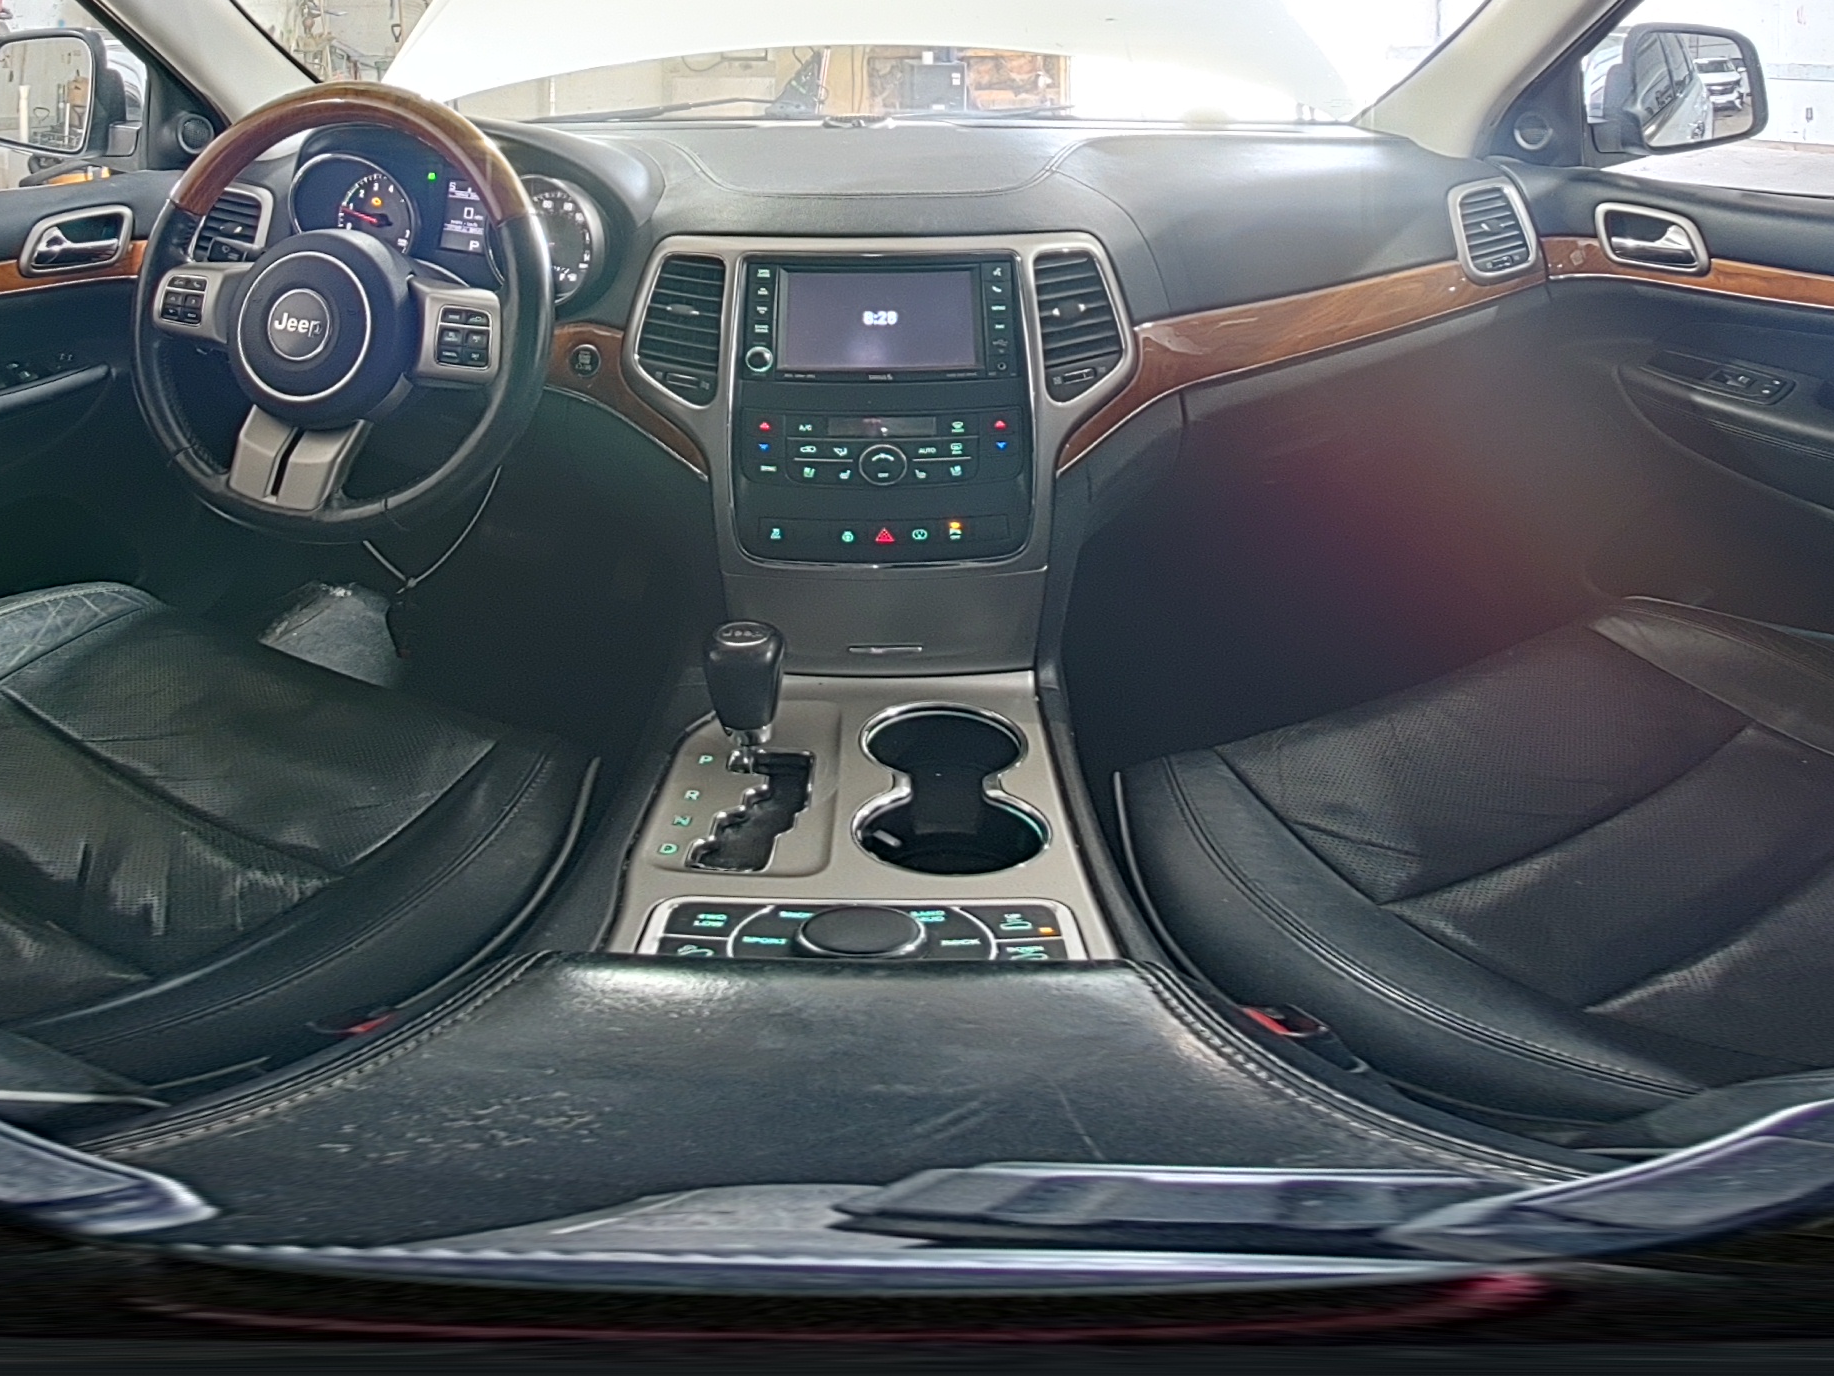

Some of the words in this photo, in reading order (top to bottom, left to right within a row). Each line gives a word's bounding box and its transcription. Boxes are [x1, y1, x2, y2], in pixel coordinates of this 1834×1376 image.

[463, 206, 475, 220] 0
[468, 240, 481, 251] P
[273, 312, 323, 338] Jeep
[917, 446, 937, 455] AUTO
[697, 754, 714, 765] P
[684, 789, 701, 800] R
[673, 815, 693, 826] N
[658, 842, 679, 854] D
